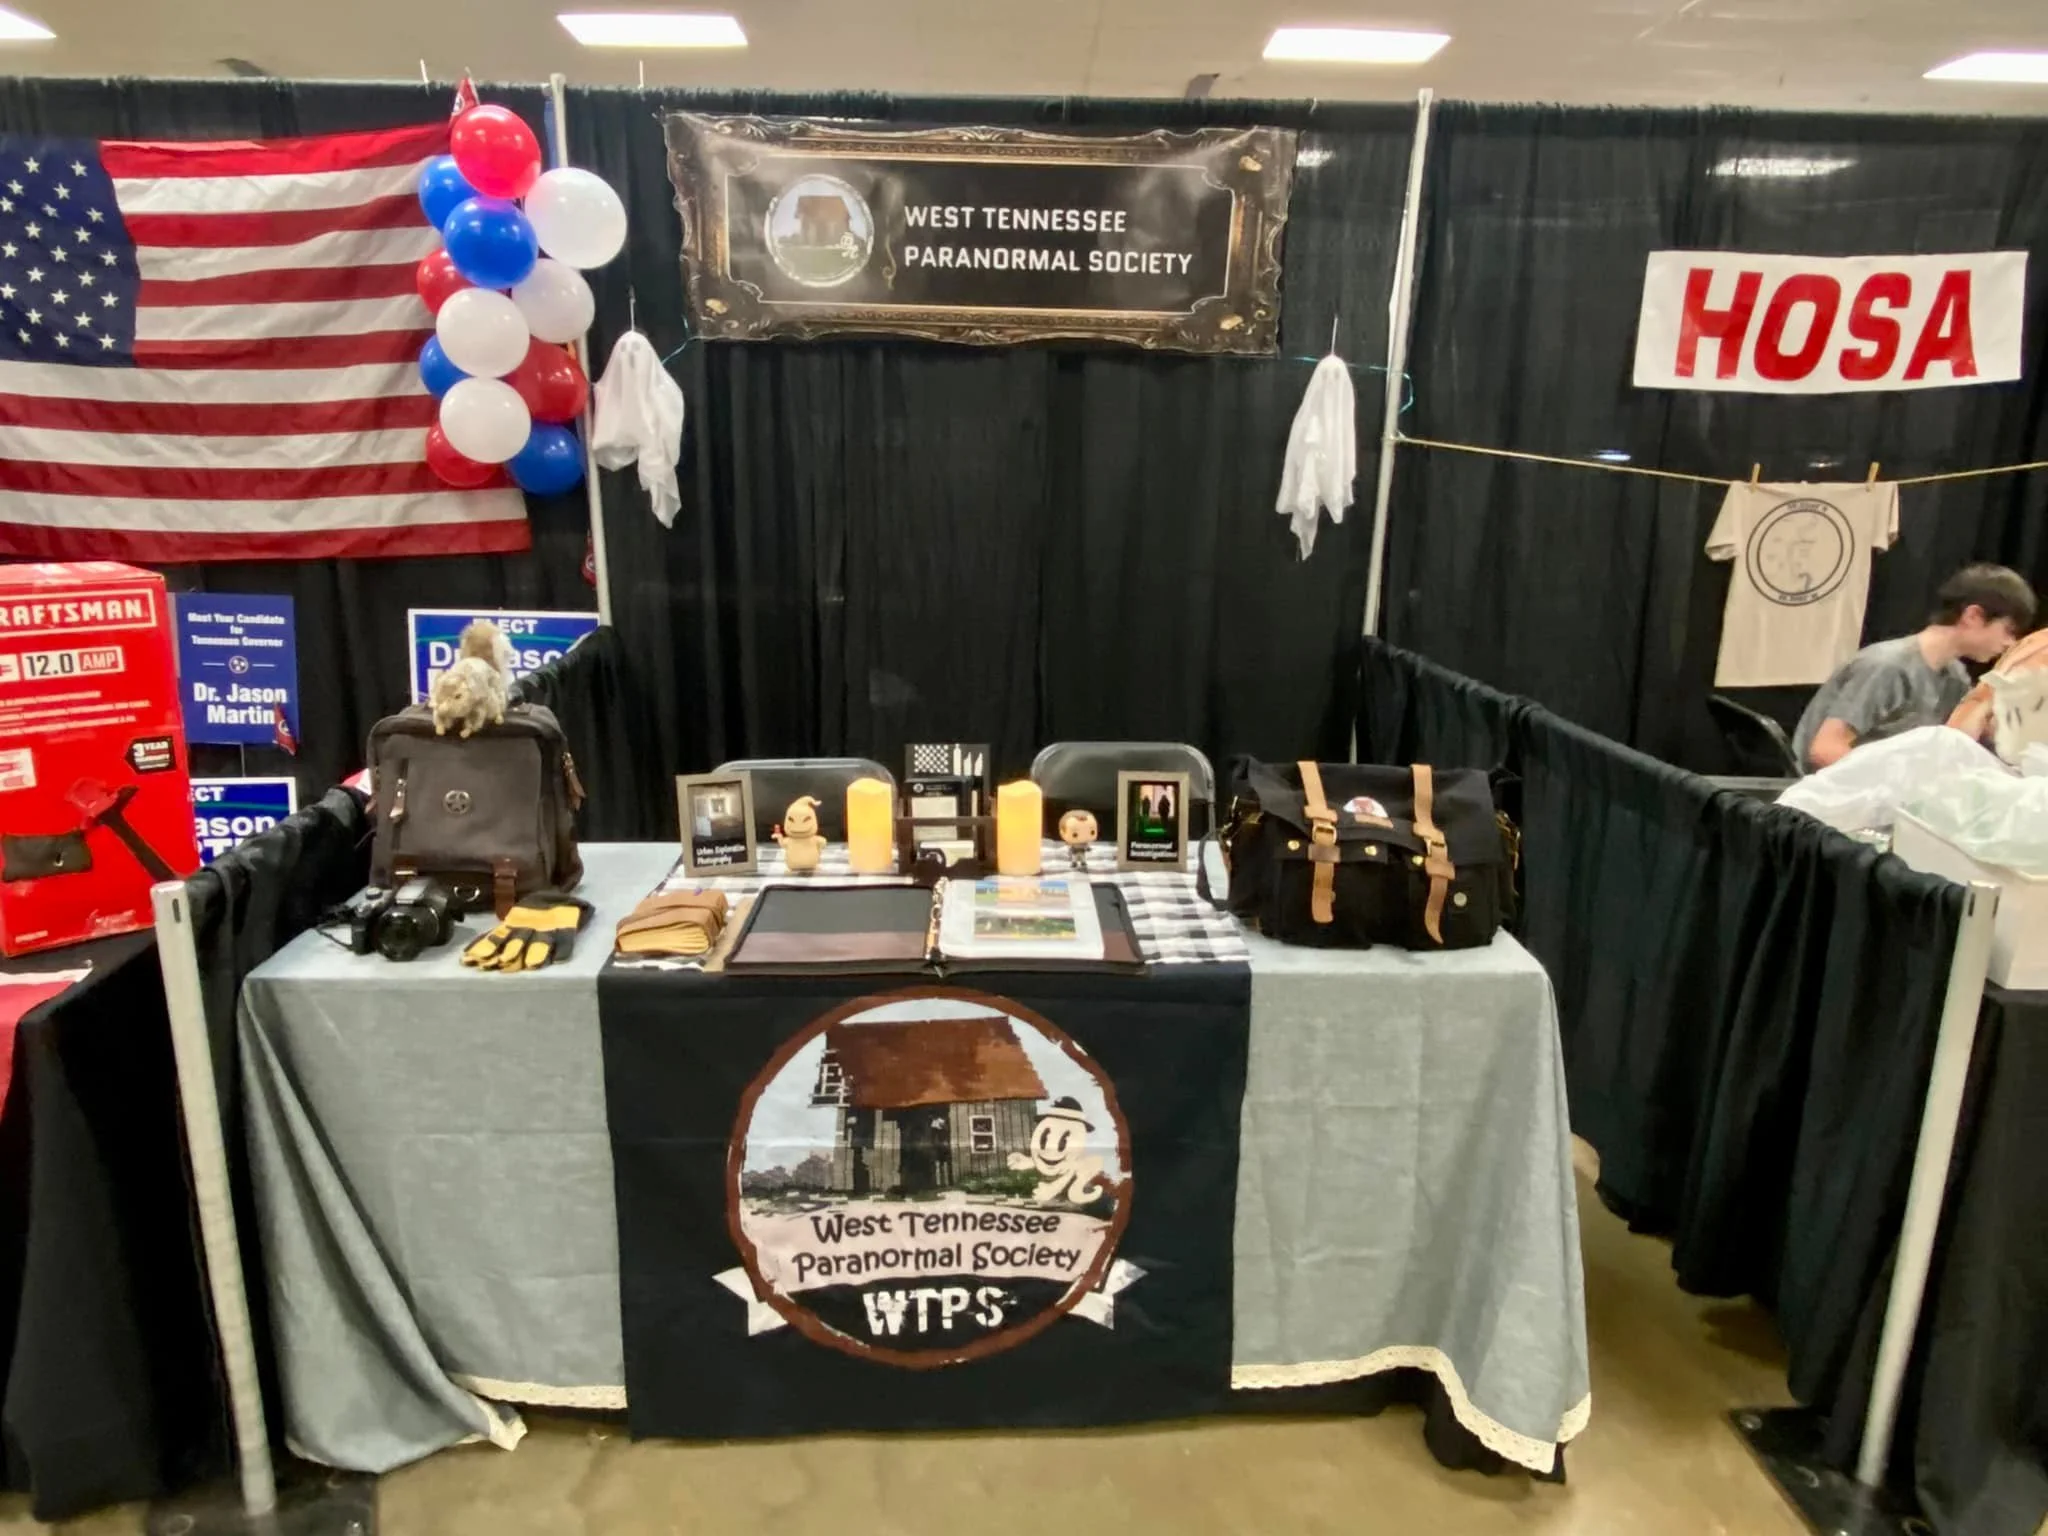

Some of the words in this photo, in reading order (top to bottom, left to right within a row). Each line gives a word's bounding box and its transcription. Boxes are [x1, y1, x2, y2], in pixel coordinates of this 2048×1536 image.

[904, 206, 975, 229] WEST
[982, 207, 1128, 232] TENNESSEE
[904, 246, 1081, 271] PARANORMAL
[1089, 250, 1192, 275] SOCIETY
[1674, 268, 1978, 381] HOSA
[0, 599, 142, 627] RAFTSMAN
[26, 653, 74, 676] 12.0
[82, 652, 116, 670] AMP
[193, 682, 221, 702] Dr.
[226, 683, 287, 703] Jason
[207, 705, 275, 724] Martin
[132, 743, 144, 757] 3
[194, 816, 275, 837] ason
[810, 1212, 892, 1243] West
[898, 1211, 1061, 1237] Tennessee
[792, 1243, 962, 1282] Paranormal
[972, 1242, 1081, 1272] Society
[863, 1286, 1005, 1335] WTPS
